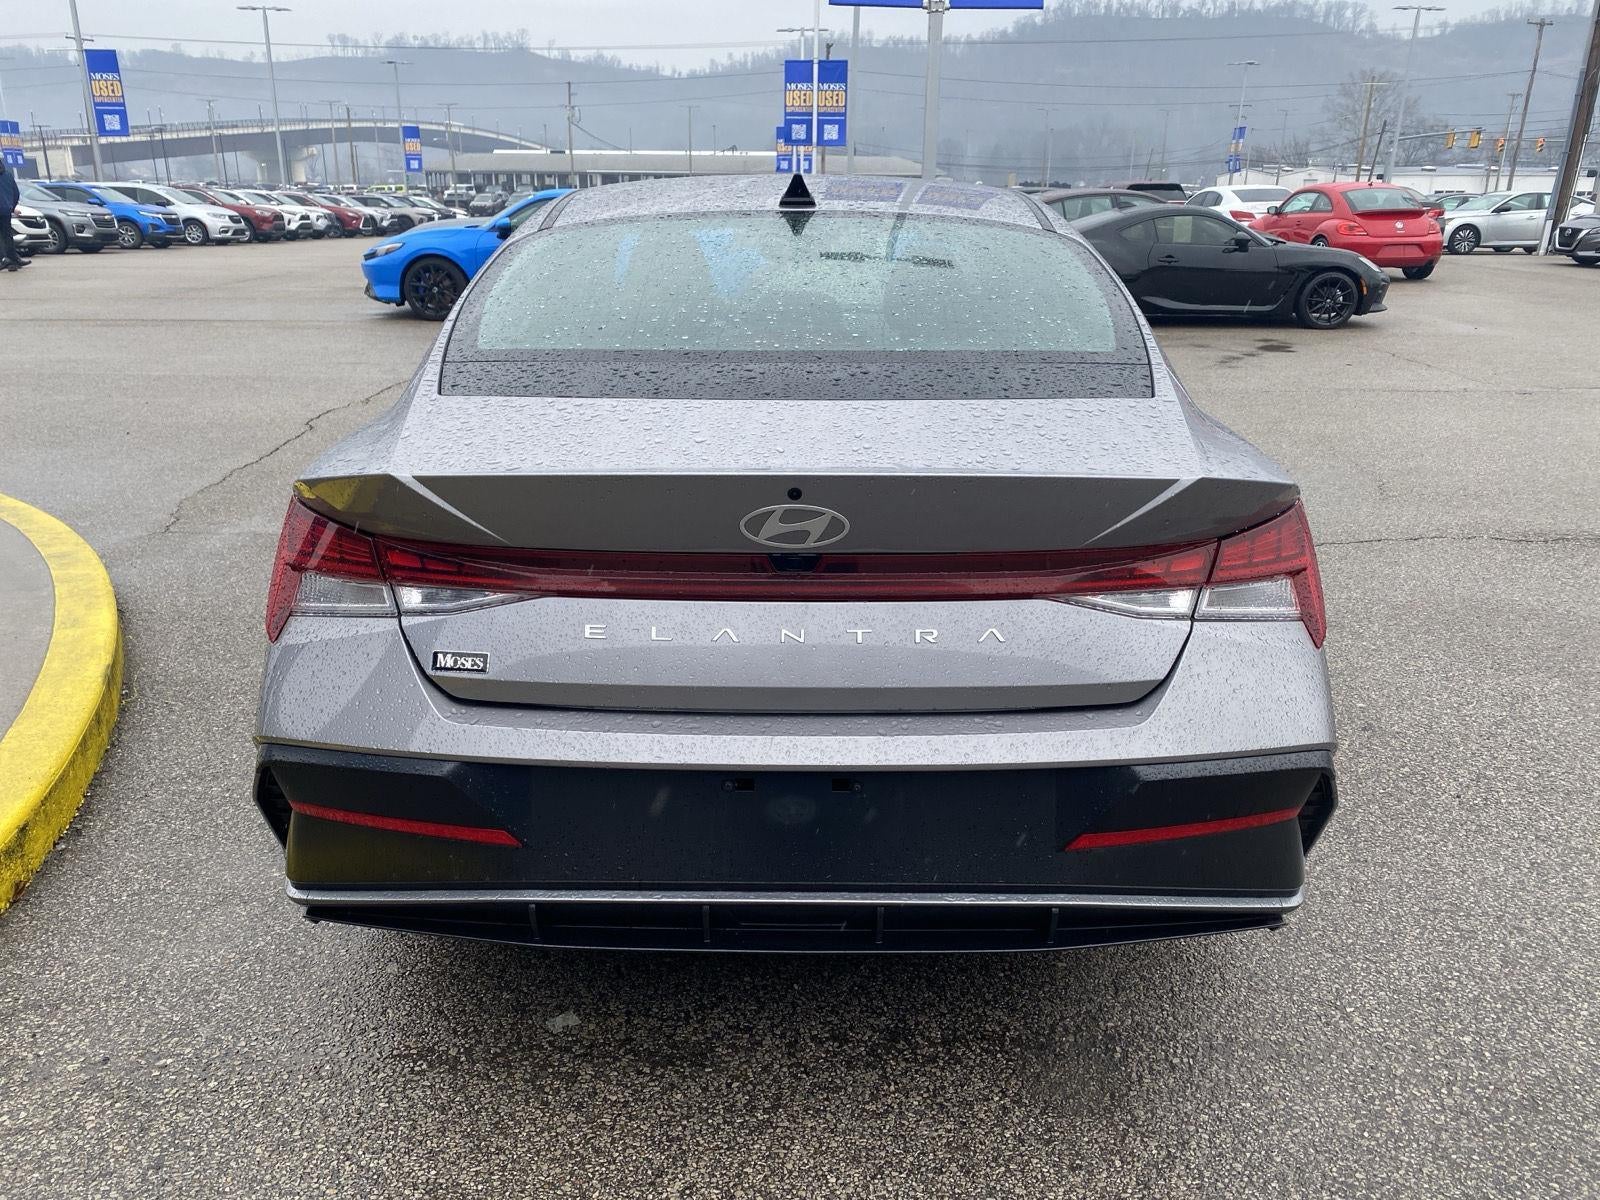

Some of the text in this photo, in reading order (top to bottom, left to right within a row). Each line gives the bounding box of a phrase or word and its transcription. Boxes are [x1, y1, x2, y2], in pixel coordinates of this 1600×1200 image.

[90, 72, 120, 80] MOSES
[91, 80, 123, 96] USED
[786, 90, 813, 106] USED
[818, 90, 846, 107] USED
[583, 624, 1006, 645] ELANTRA
